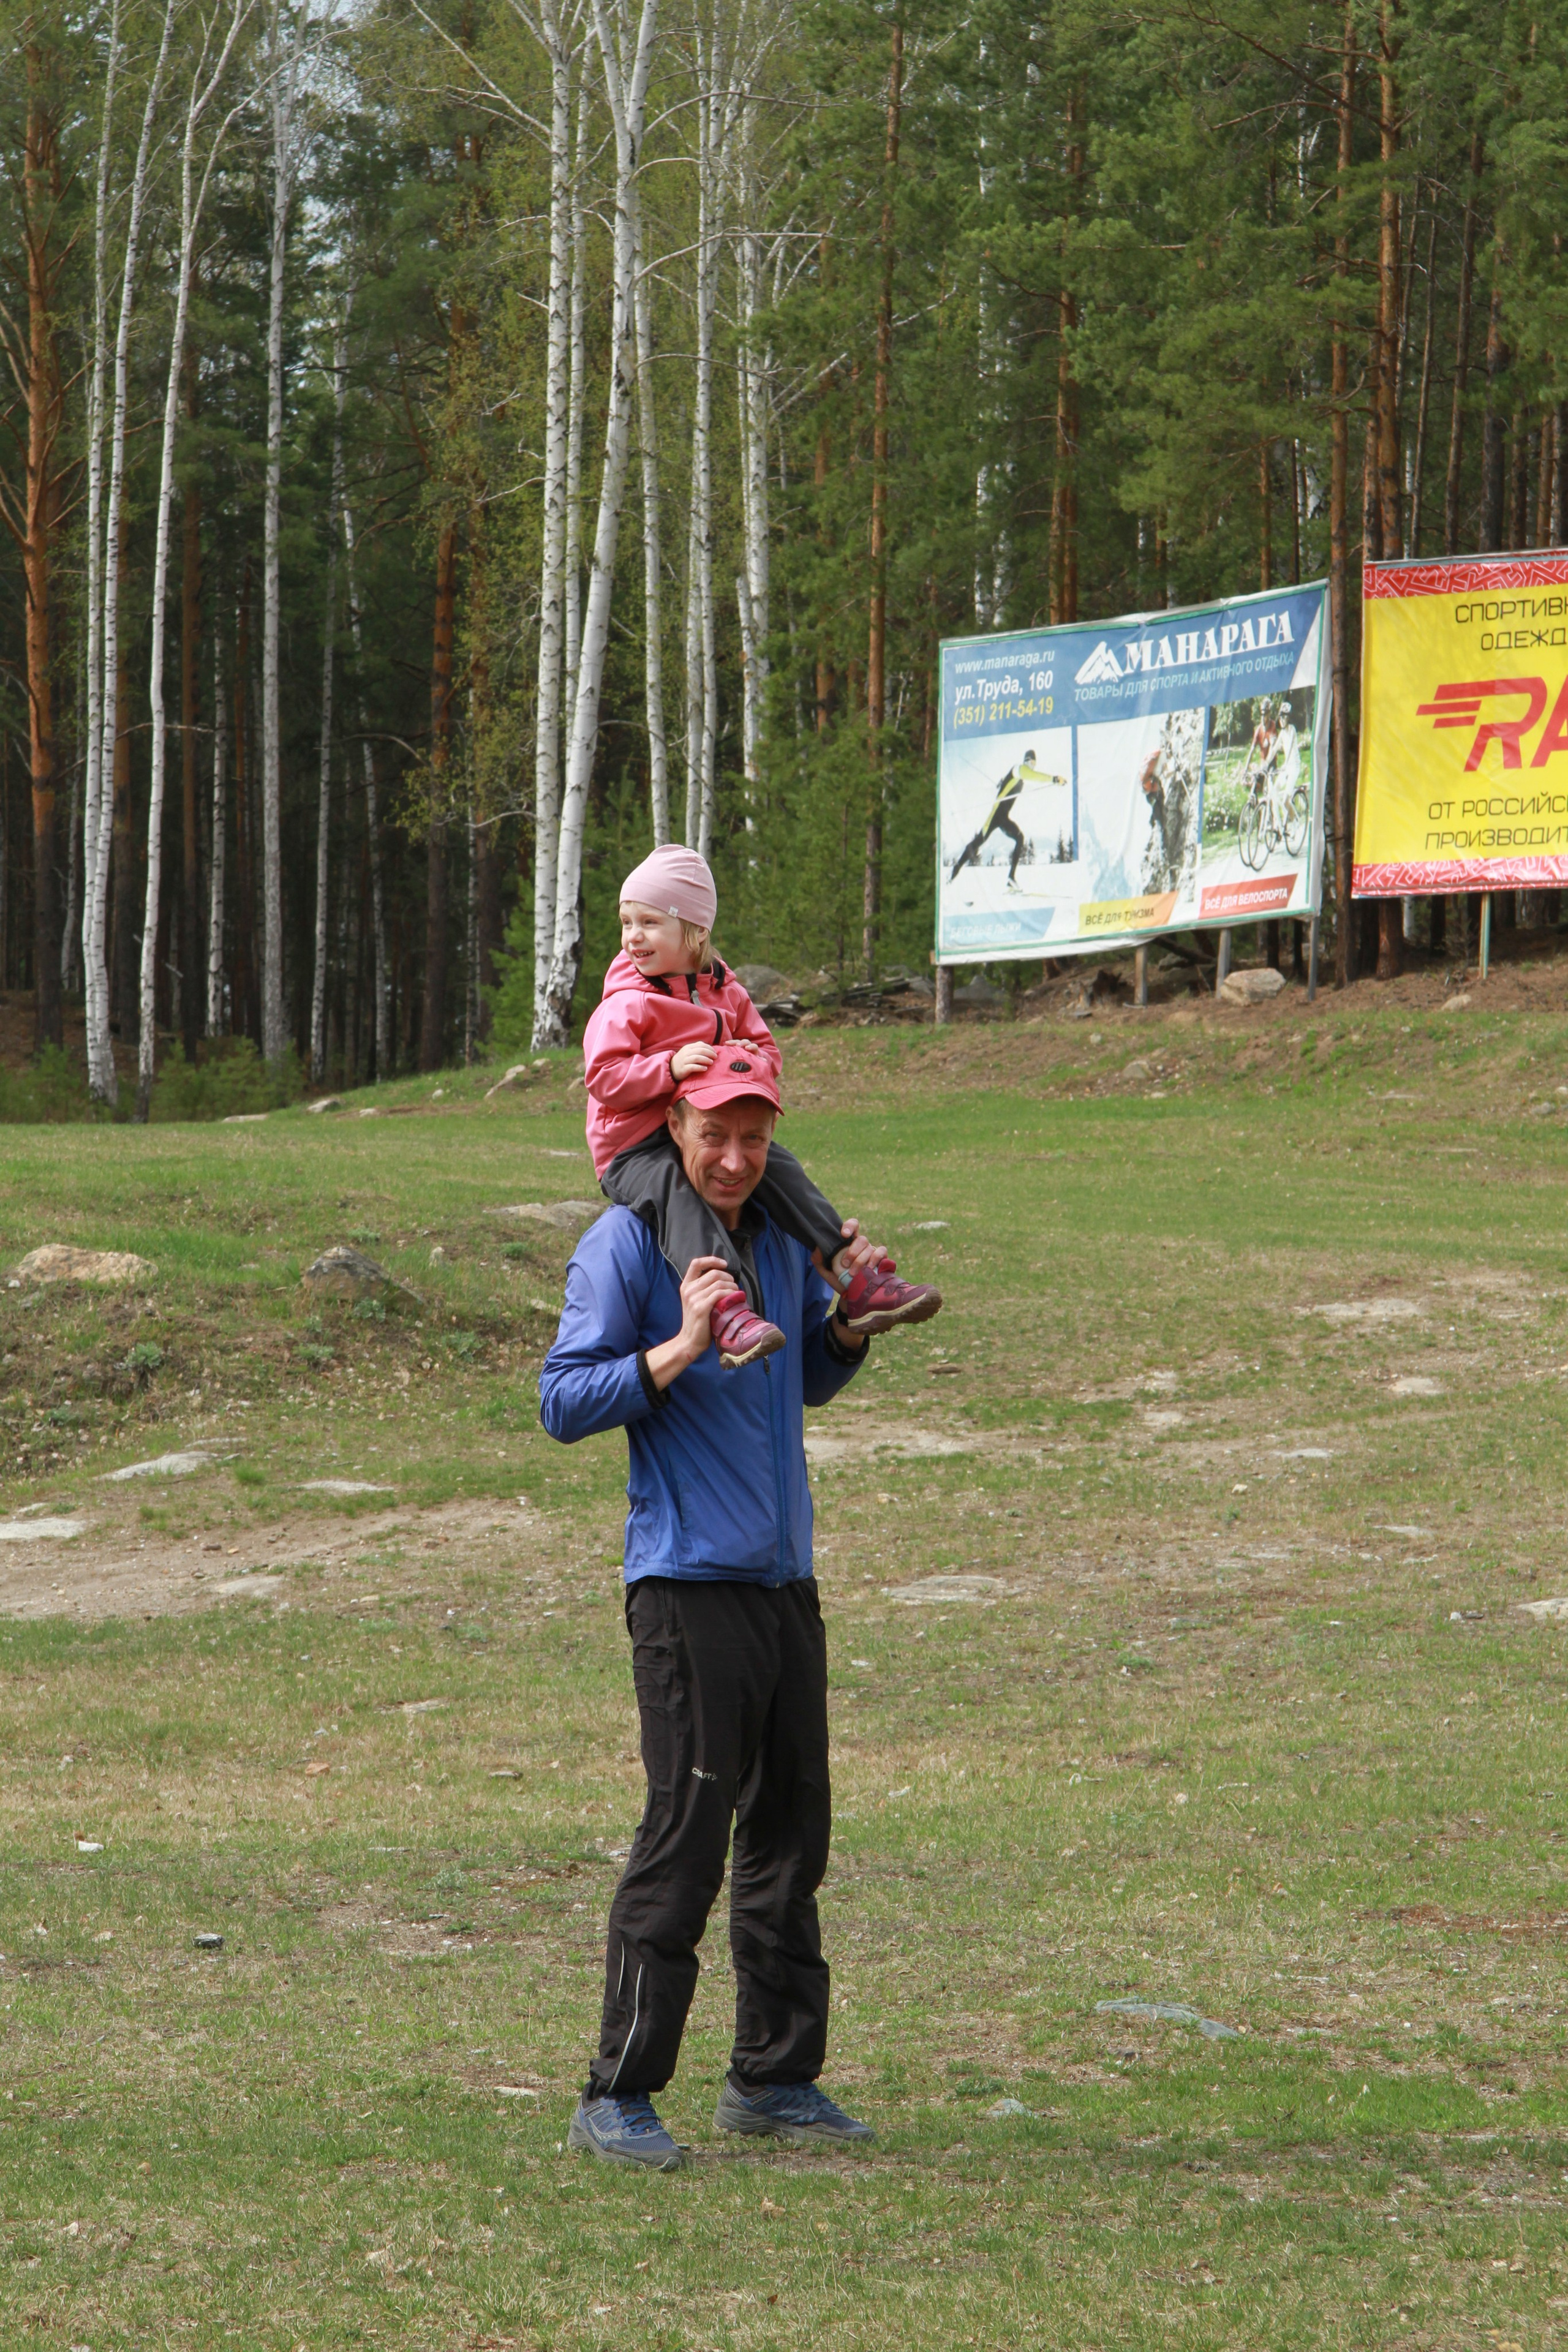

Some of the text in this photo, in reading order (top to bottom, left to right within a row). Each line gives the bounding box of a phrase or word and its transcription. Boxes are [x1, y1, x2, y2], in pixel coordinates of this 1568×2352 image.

[1123, 611, 1295, 674] МАНАРАГА
[955, 650, 1055, 674] www.manaraga.ru
[1074, 652, 1294, 702] ТОВАРЫ ДЛЯ СПОРТА И АКТИВНОГО ОТДЫХА
[955, 670, 1054, 706] ул.Труда, 160
[954, 696, 1054, 729] (351) 211-54-19
[1428, 791, 1568, 820] ОТ РОССИЙС
[1205, 888, 1288, 910] ВСЁ ДЛЯ ВЕЛОСПОРТА
[692, 1767, 712, 1779] CRAFT
